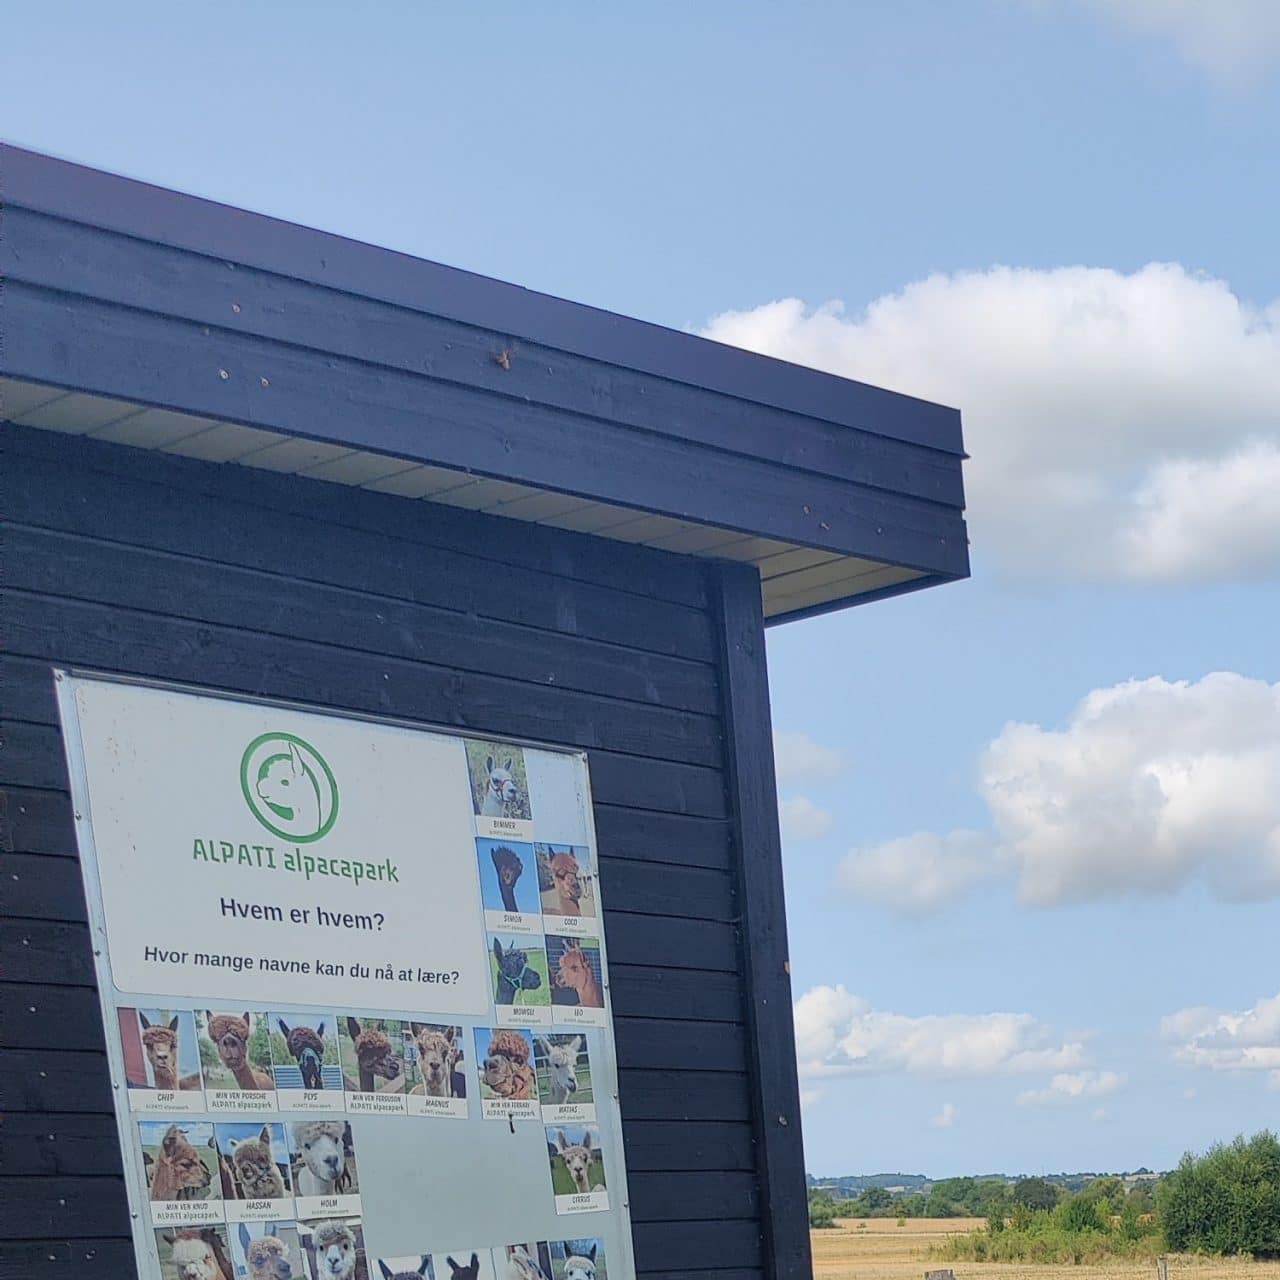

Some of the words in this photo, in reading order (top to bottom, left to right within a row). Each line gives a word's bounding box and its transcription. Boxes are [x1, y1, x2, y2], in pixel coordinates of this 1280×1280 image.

[193, 838, 277, 870] ALPATI
[283, 847, 400, 887] alpacapark
[220, 897, 284, 922] Hvem
[290, 908, 311, 924] er
[317, 906, 385, 931] hvem?
[143, 946, 189, 964] Hvor
[193, 951, 254, 972] mange
[259, 956, 311, 974] navne
[315, 960, 345, 977] kan
[349, 963, 370, 979] du
[374, 963, 394, 981] nå
[398, 967, 413, 982] at
[417, 967, 460, 985] lære?
[246, 1201, 272, 1210] HASSAN
